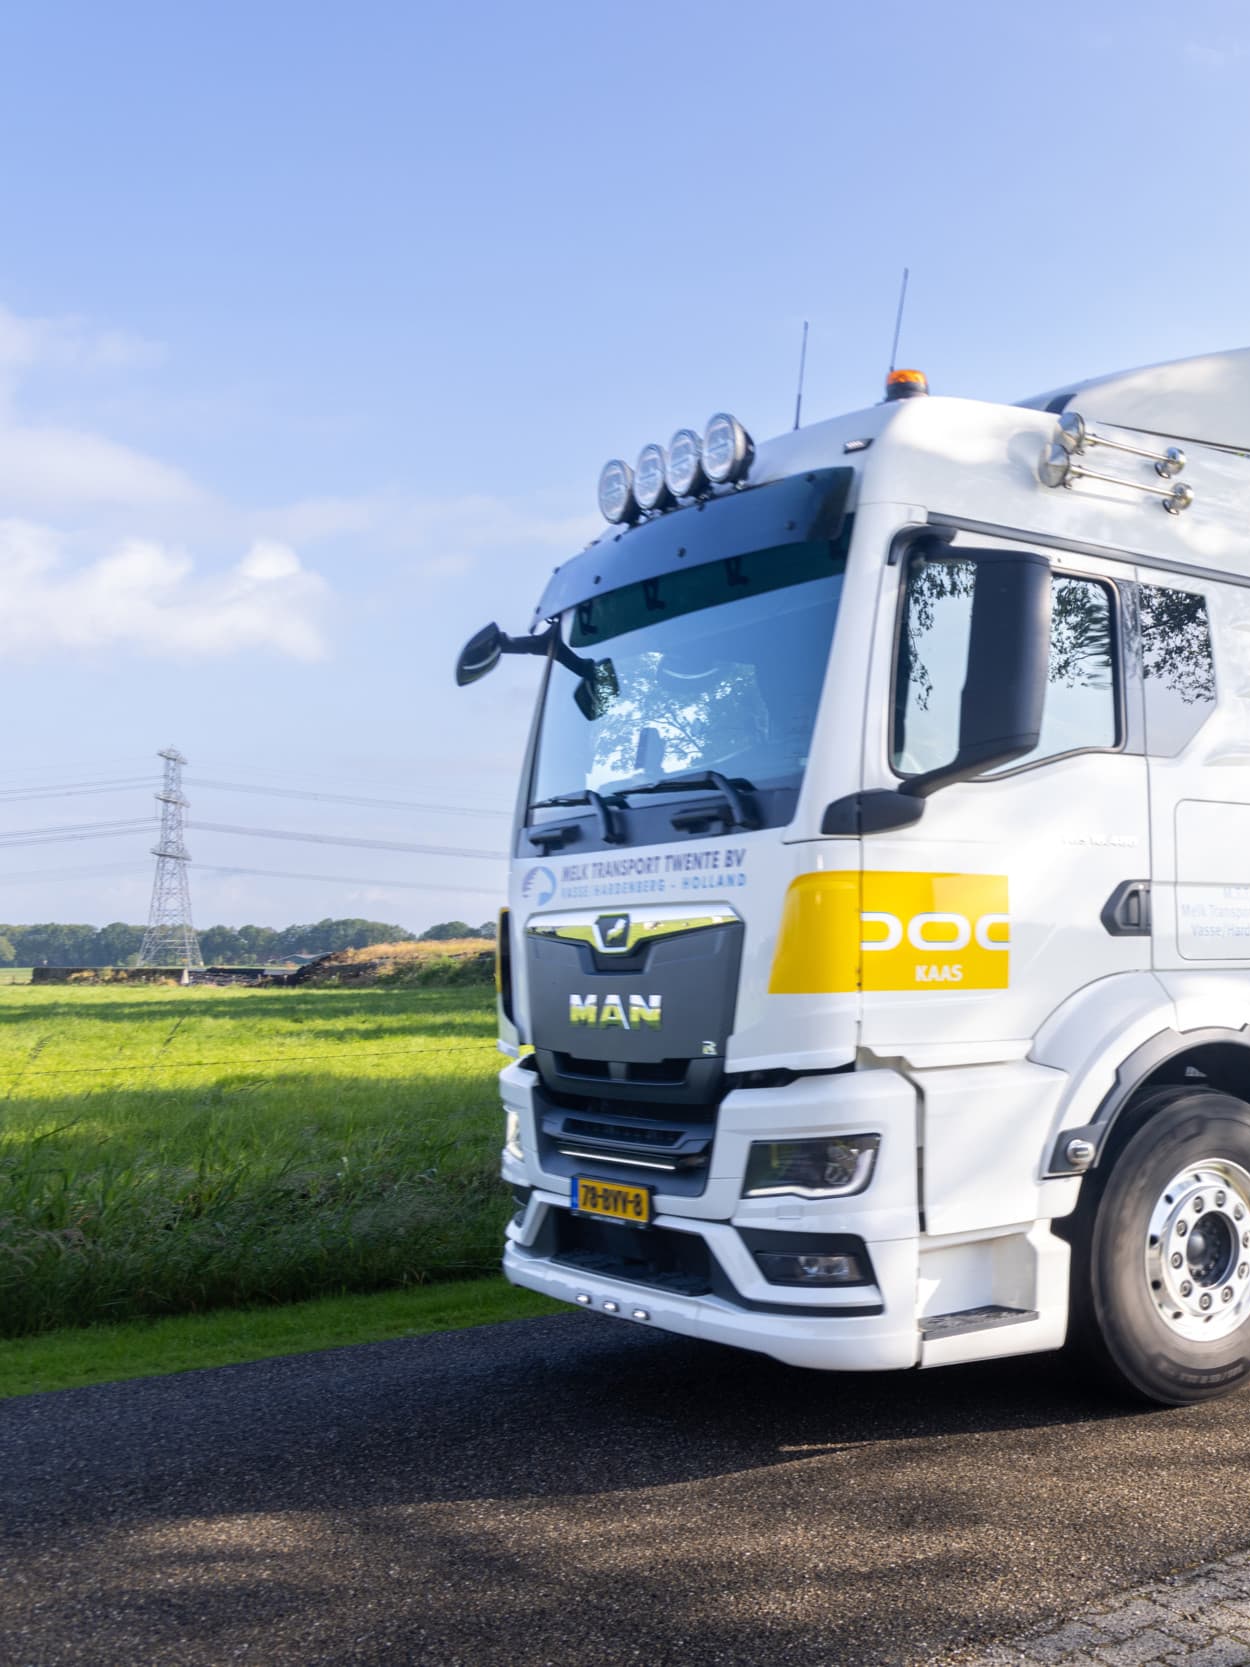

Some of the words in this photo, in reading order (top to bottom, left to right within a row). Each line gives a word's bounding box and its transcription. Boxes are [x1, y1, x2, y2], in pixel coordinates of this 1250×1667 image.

[561, 864, 588, 881] MELK
[592, 856, 661, 878] TRANSPORT
[664, 850, 720, 872] TWENTE
[724, 848, 747, 867] BV
[681, 873, 747, 889] HOLLAND
[914, 964, 963, 982] KAAS
[569, 994, 662, 1030] MAN
